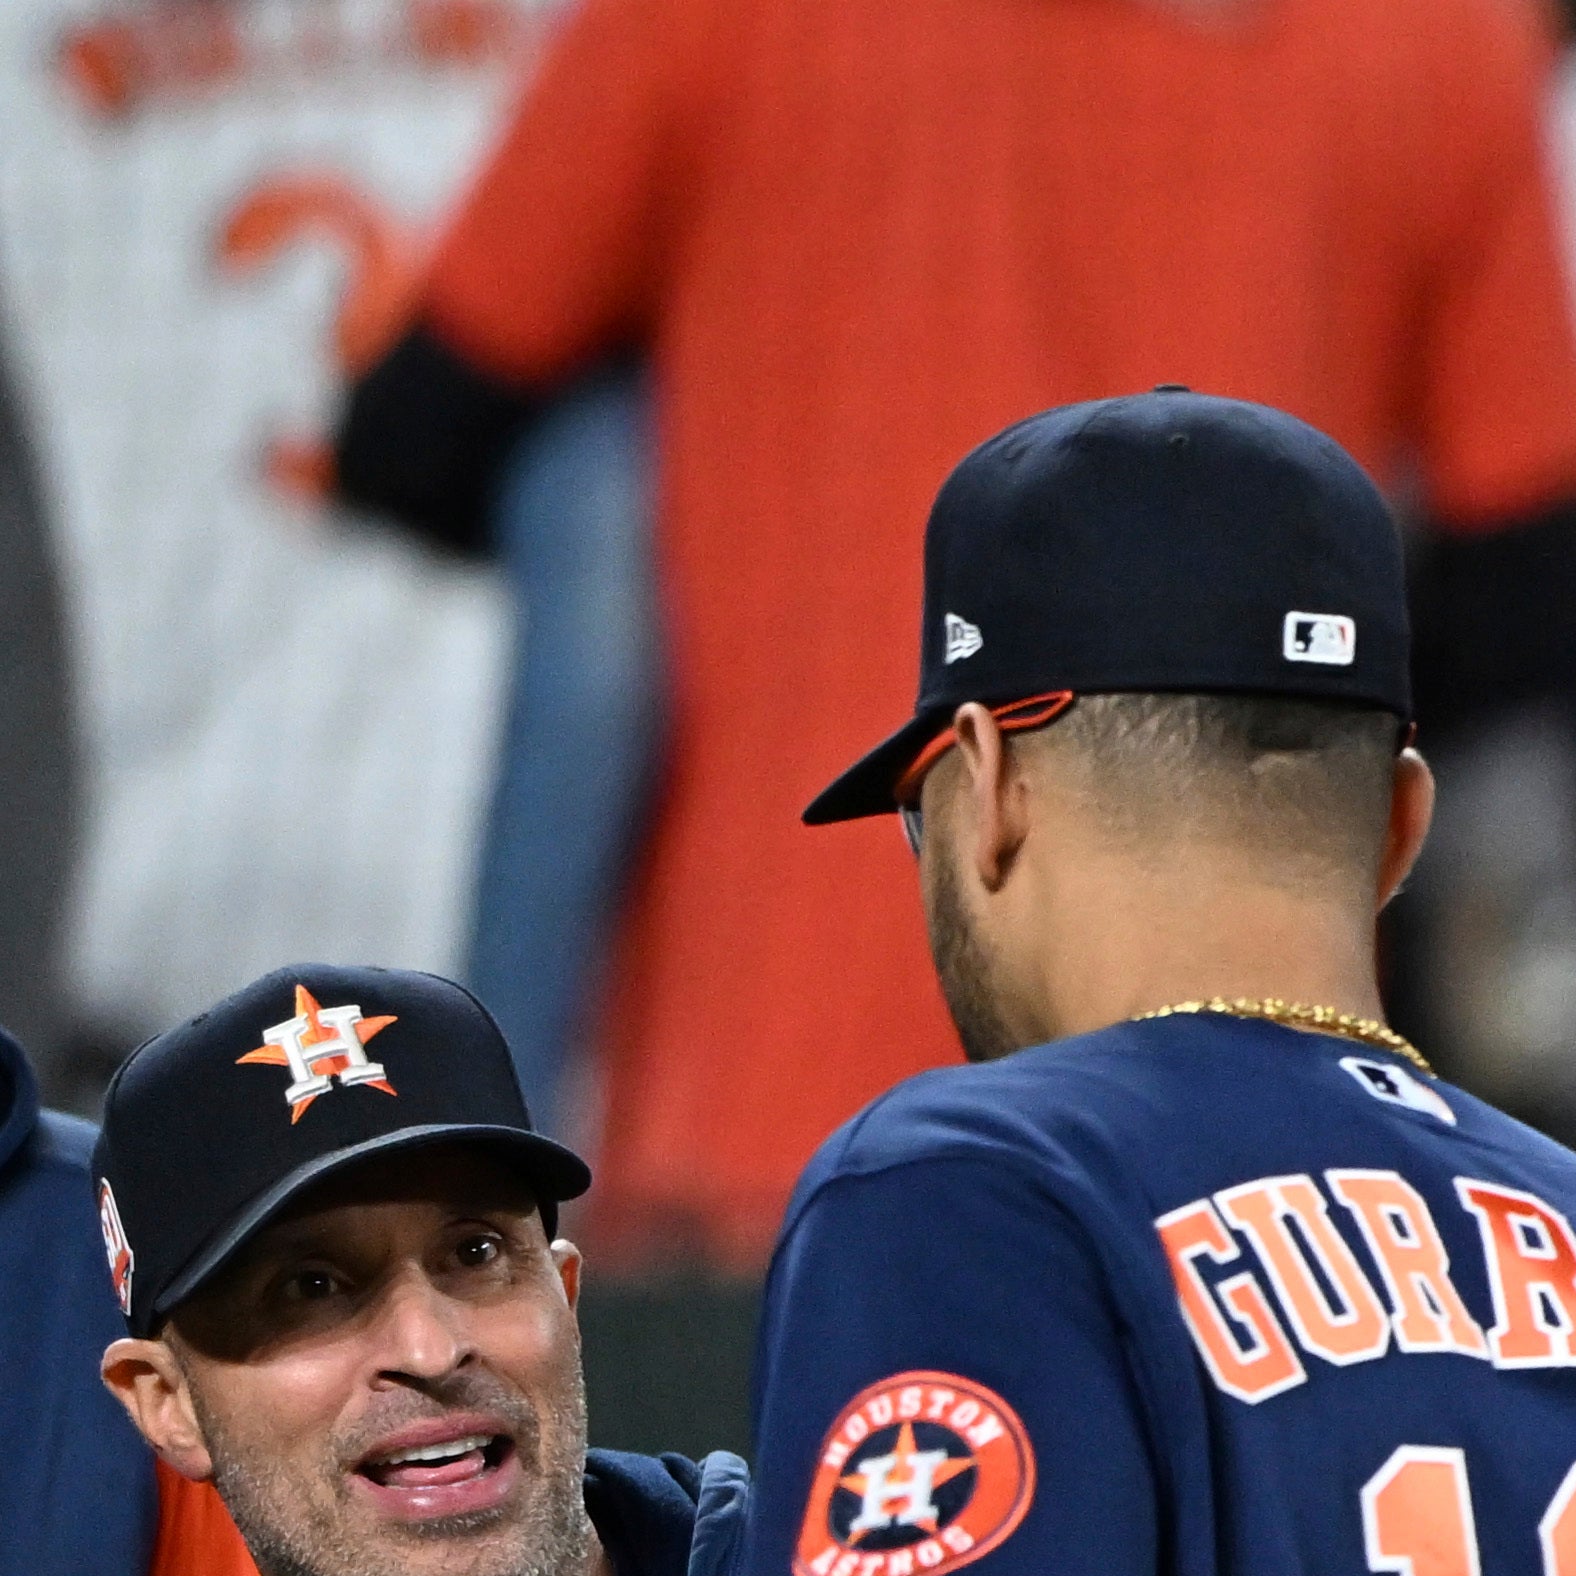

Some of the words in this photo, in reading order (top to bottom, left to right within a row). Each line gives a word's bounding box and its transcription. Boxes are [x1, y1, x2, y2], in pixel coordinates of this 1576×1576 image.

[262, 1003, 386, 1108] H
[823, 1385, 1005, 1467] HOUSTON
[849, 1448, 949, 1532] H
